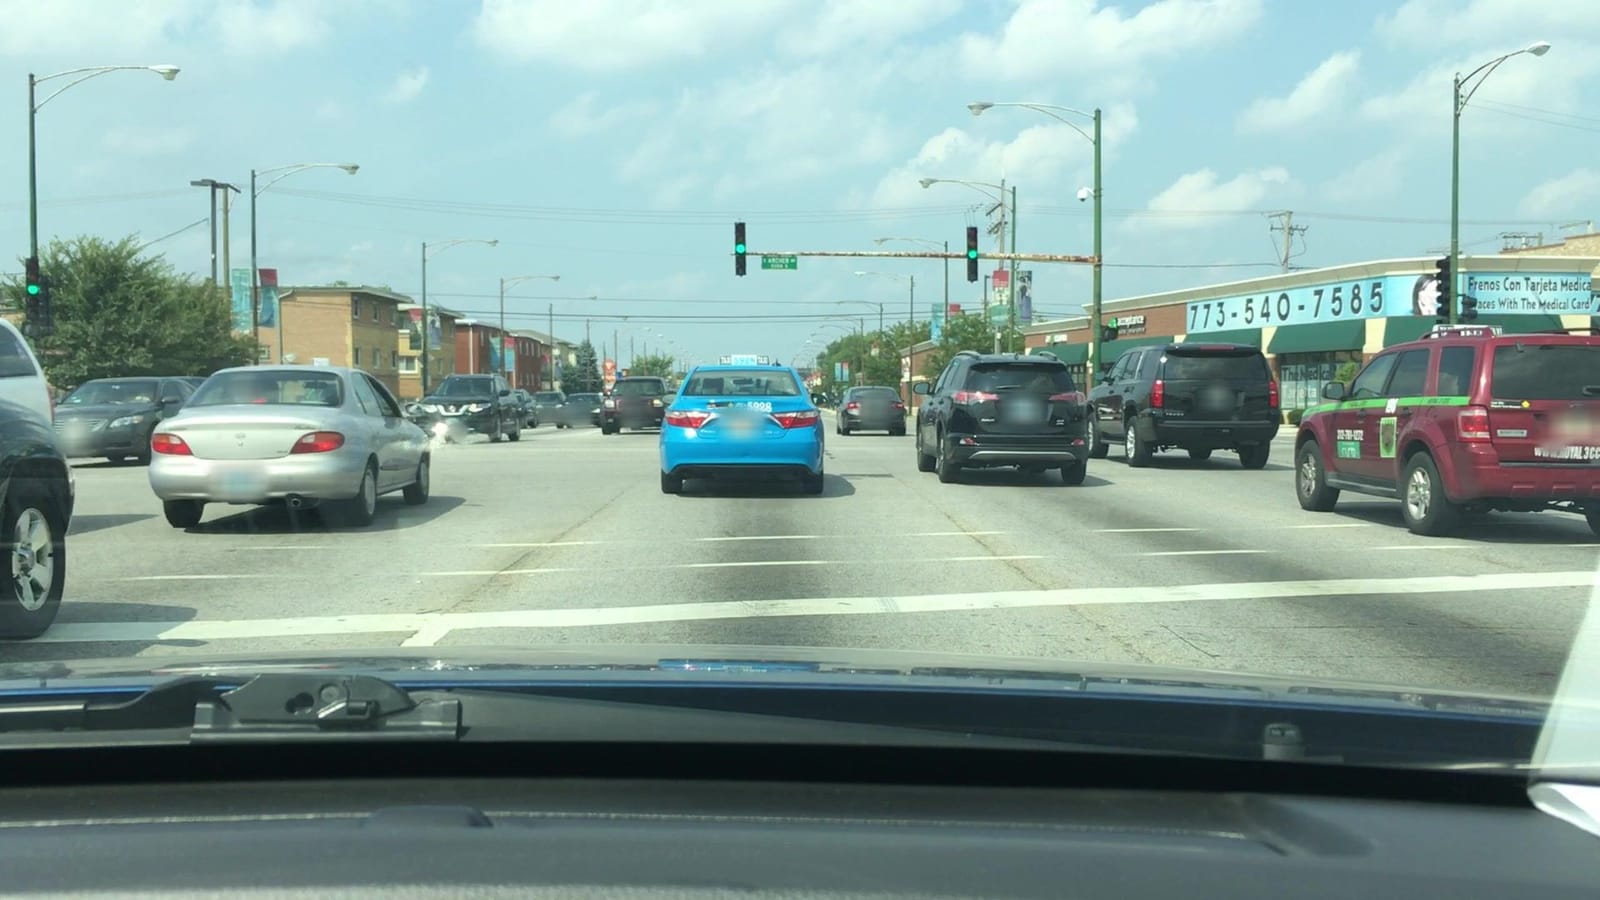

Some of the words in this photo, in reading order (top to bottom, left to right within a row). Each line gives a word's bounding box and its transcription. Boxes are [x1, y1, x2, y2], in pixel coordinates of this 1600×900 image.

[1468, 277, 1500, 291] Frenos
[1503, 277, 1521, 291] Con
[1524, 277, 1558, 294] Tarjeta
[1560, 277, 1591, 291] Medica
[1189, 281, 1383, 330] 773-540-7585
[1498, 298, 1518, 309] With
[1520, 298, 1536, 309] The
[1538, 298, 1569, 309] Medical
[1571, 298, 1590, 309] Card
